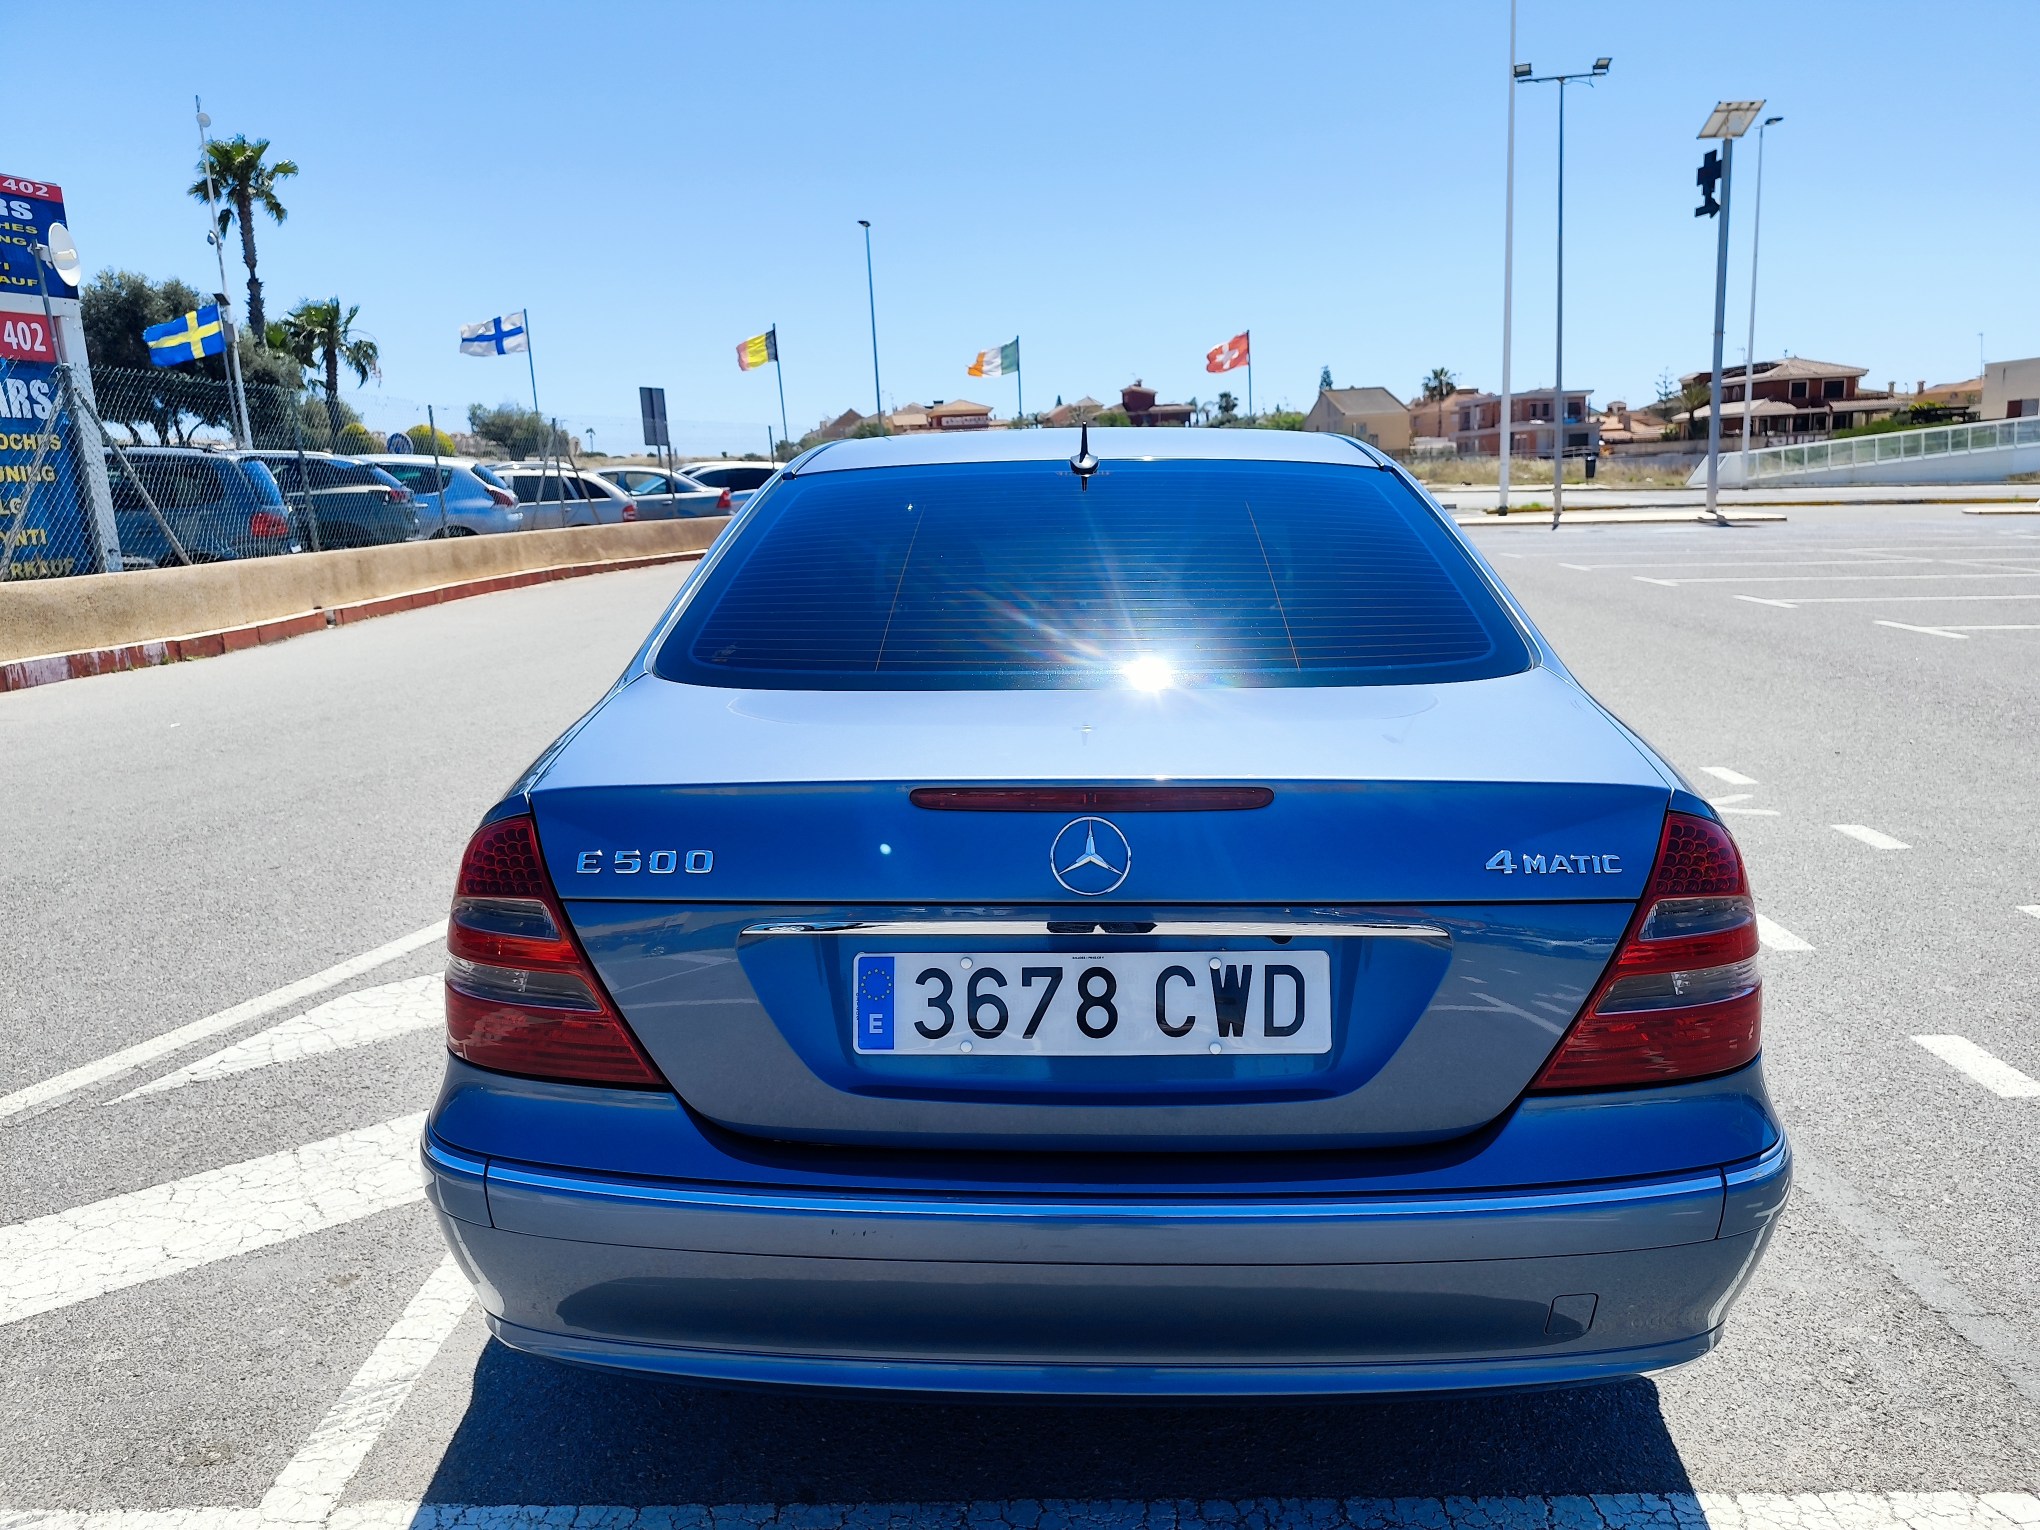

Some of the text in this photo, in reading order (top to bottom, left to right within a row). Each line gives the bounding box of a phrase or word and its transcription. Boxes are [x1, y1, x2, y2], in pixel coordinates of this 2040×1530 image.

[2, 178, 49, 197] 402
[0, 275, 38, 287] AUF
[4, 320, 46, 352] 402
[576, 849, 714, 874] E 500
[914, 964, 1306, 1039] 3678 CWD
[869, 1013, 883, 1034] E
